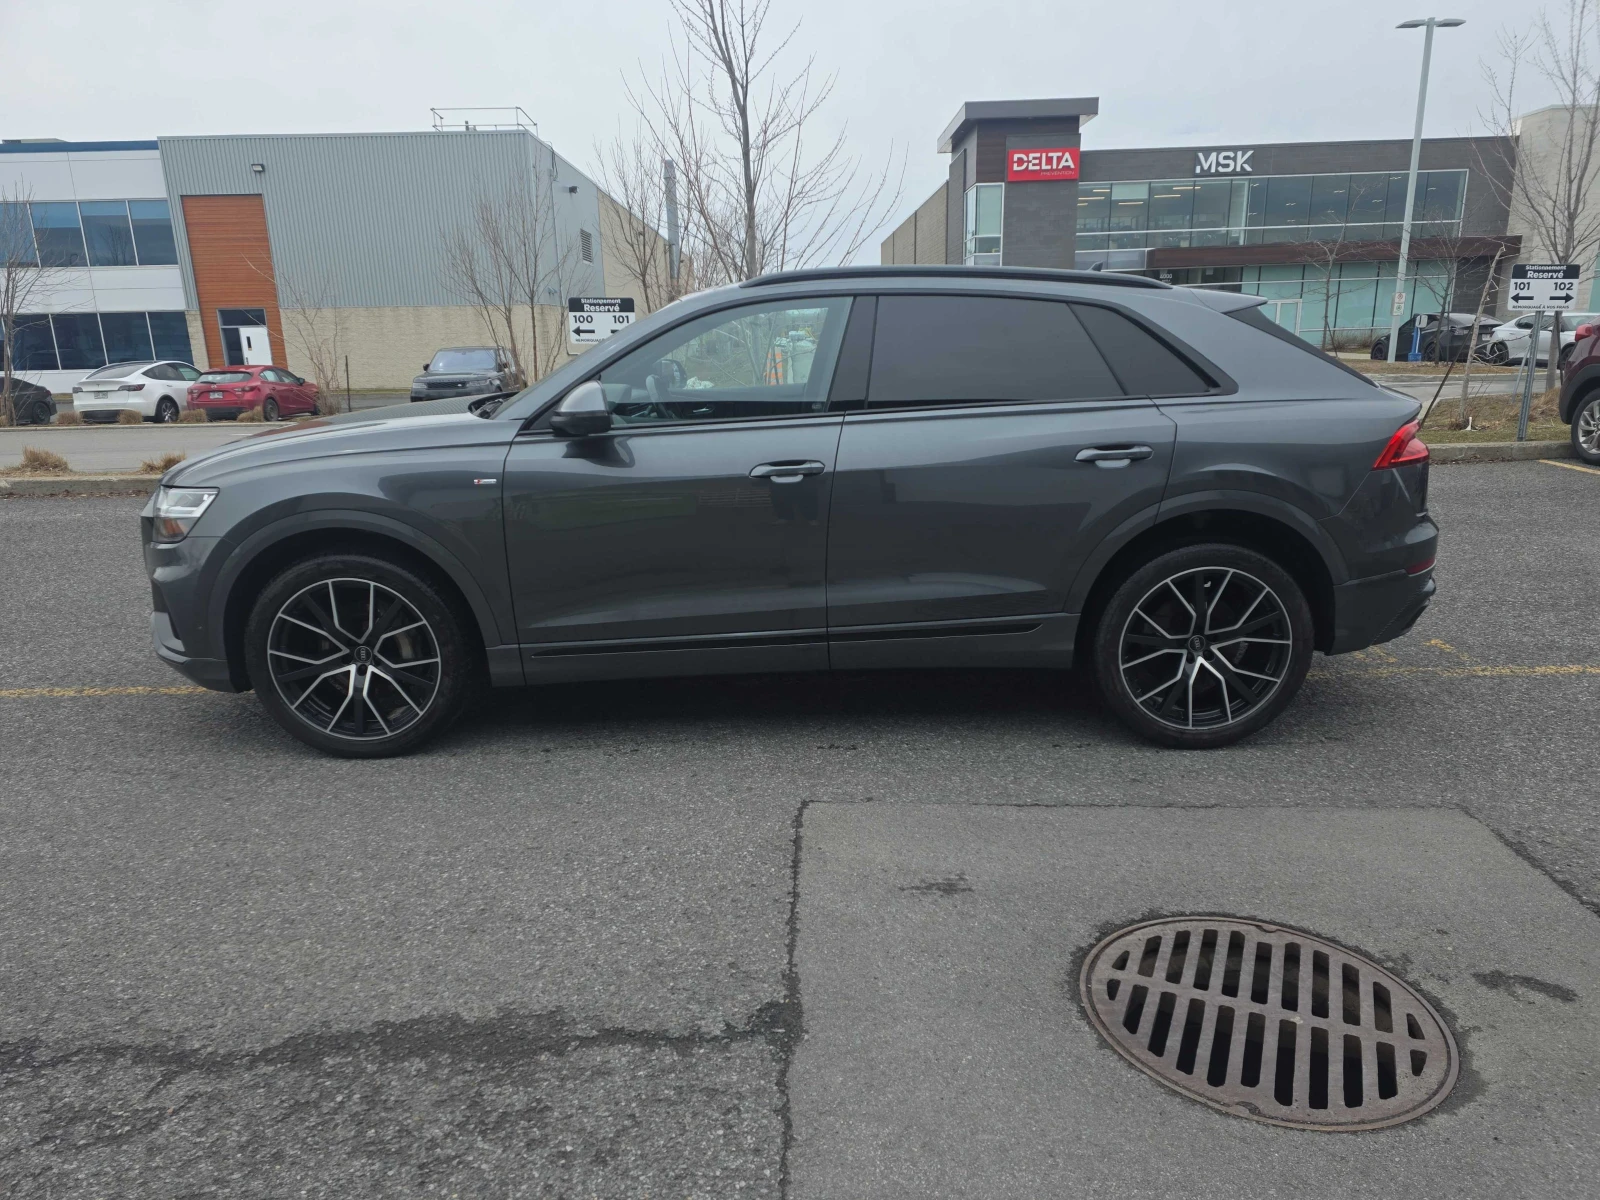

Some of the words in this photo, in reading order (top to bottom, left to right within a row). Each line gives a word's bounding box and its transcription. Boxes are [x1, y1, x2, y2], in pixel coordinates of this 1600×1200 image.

[1013, 152, 1075, 171] DELTA
[1195, 150, 1254, 173] MSK
[1527, 270, 1564, 278] Reservé
[1513, 282, 1531, 290] 101
[1553, 282, 1574, 290] 102
[583, 304, 620, 312] Reservé
[573, 315, 593, 324] 100
[612, 315, 630, 324] 101
